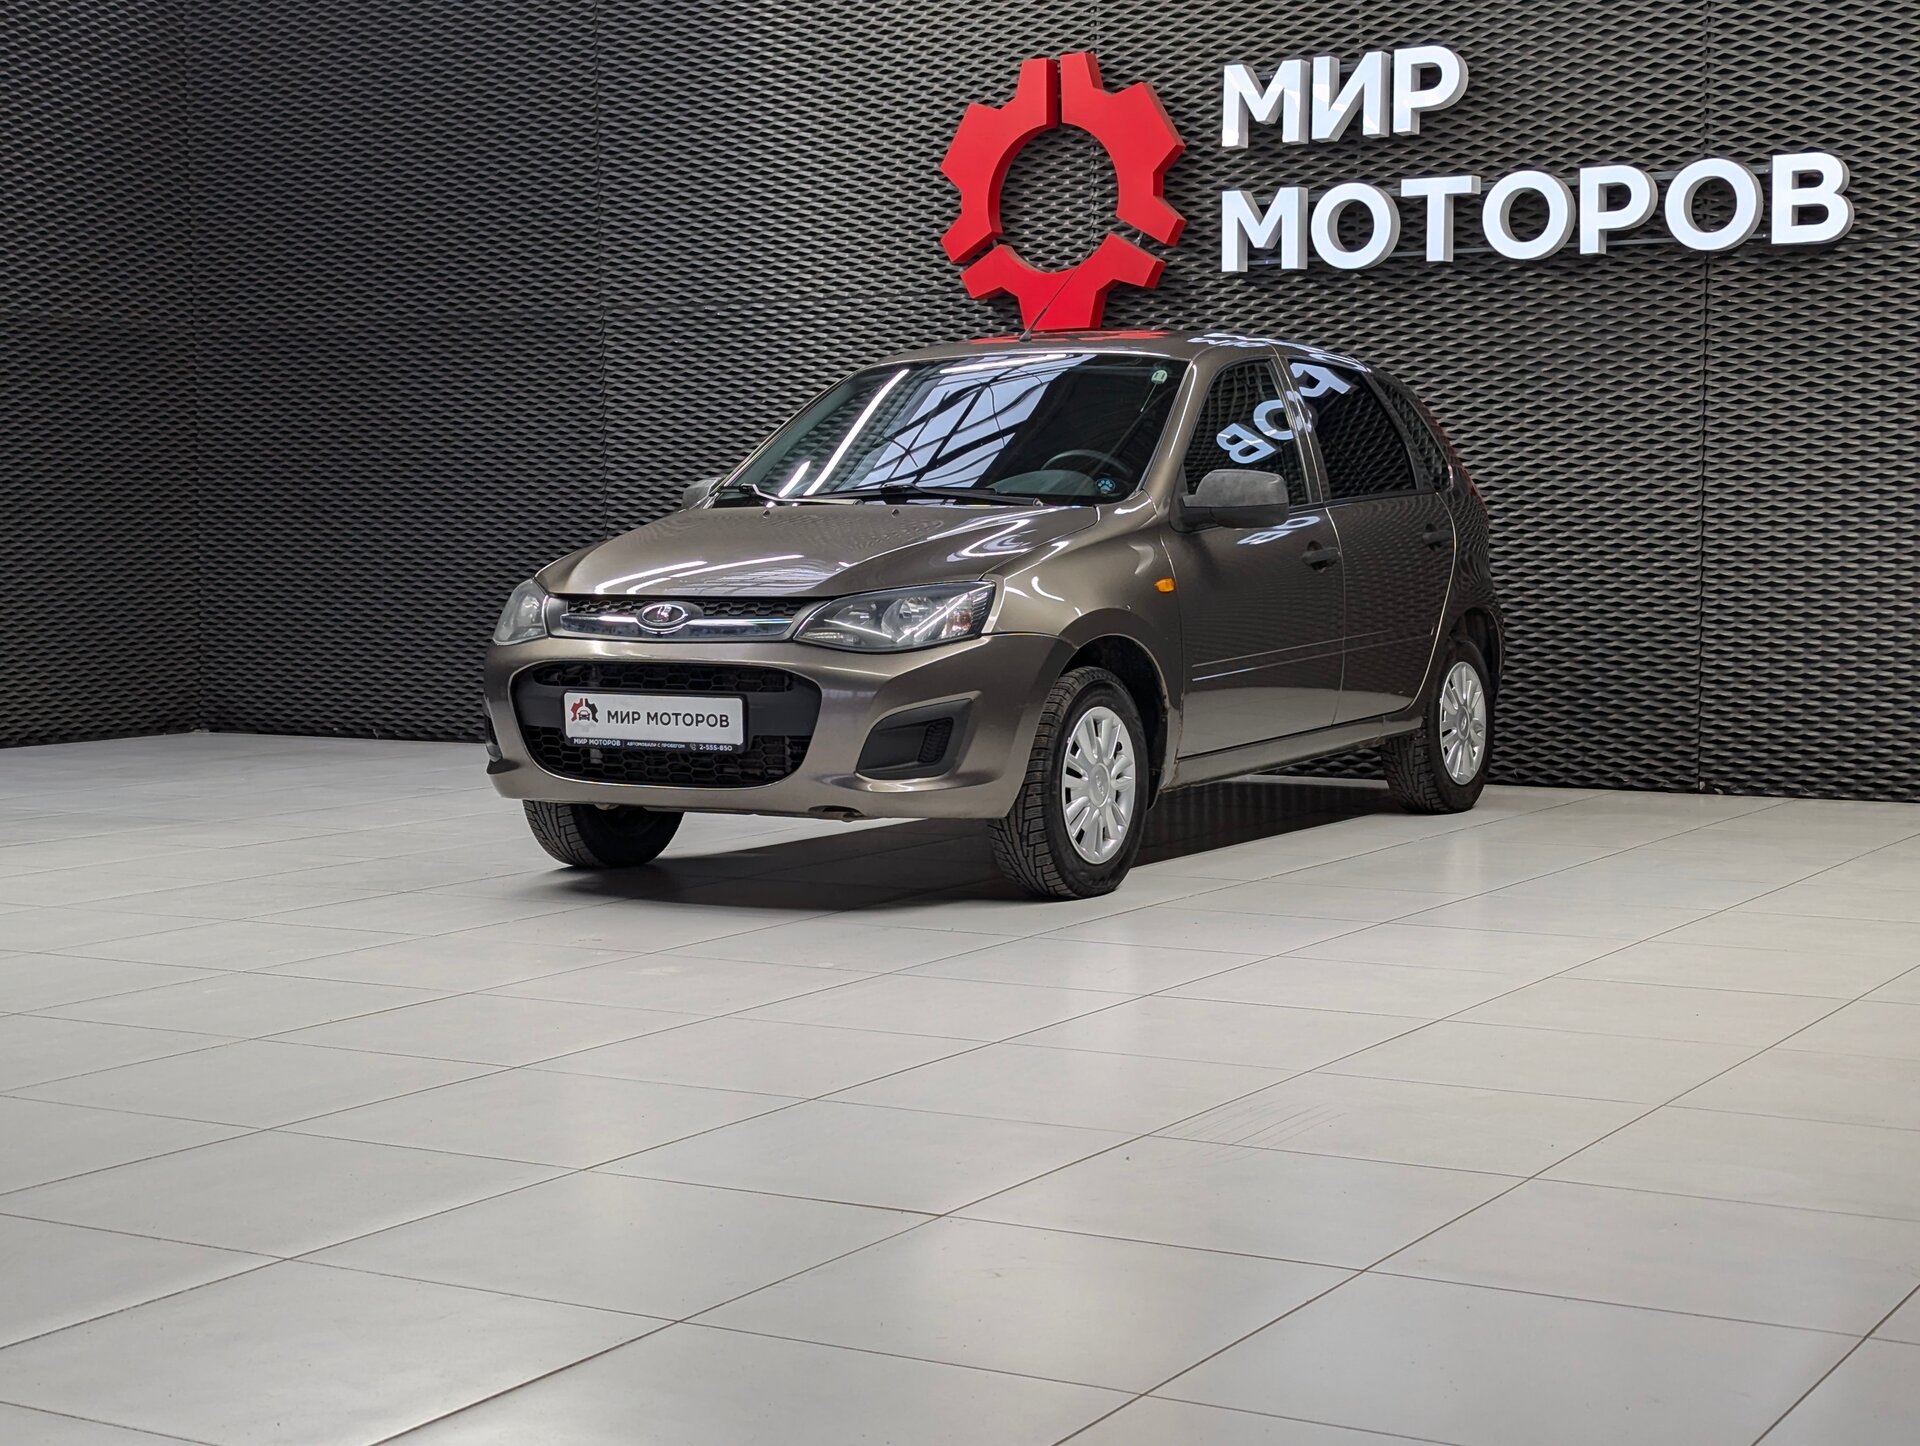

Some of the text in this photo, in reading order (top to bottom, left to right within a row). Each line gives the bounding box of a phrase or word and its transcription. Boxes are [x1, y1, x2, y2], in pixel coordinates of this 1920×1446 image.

[1222, 45, 1469, 148] МИР
[1221, 152, 1854, 272] МОТОРОВ
[607, 710, 730, 728] МИР МОТОРОВ
